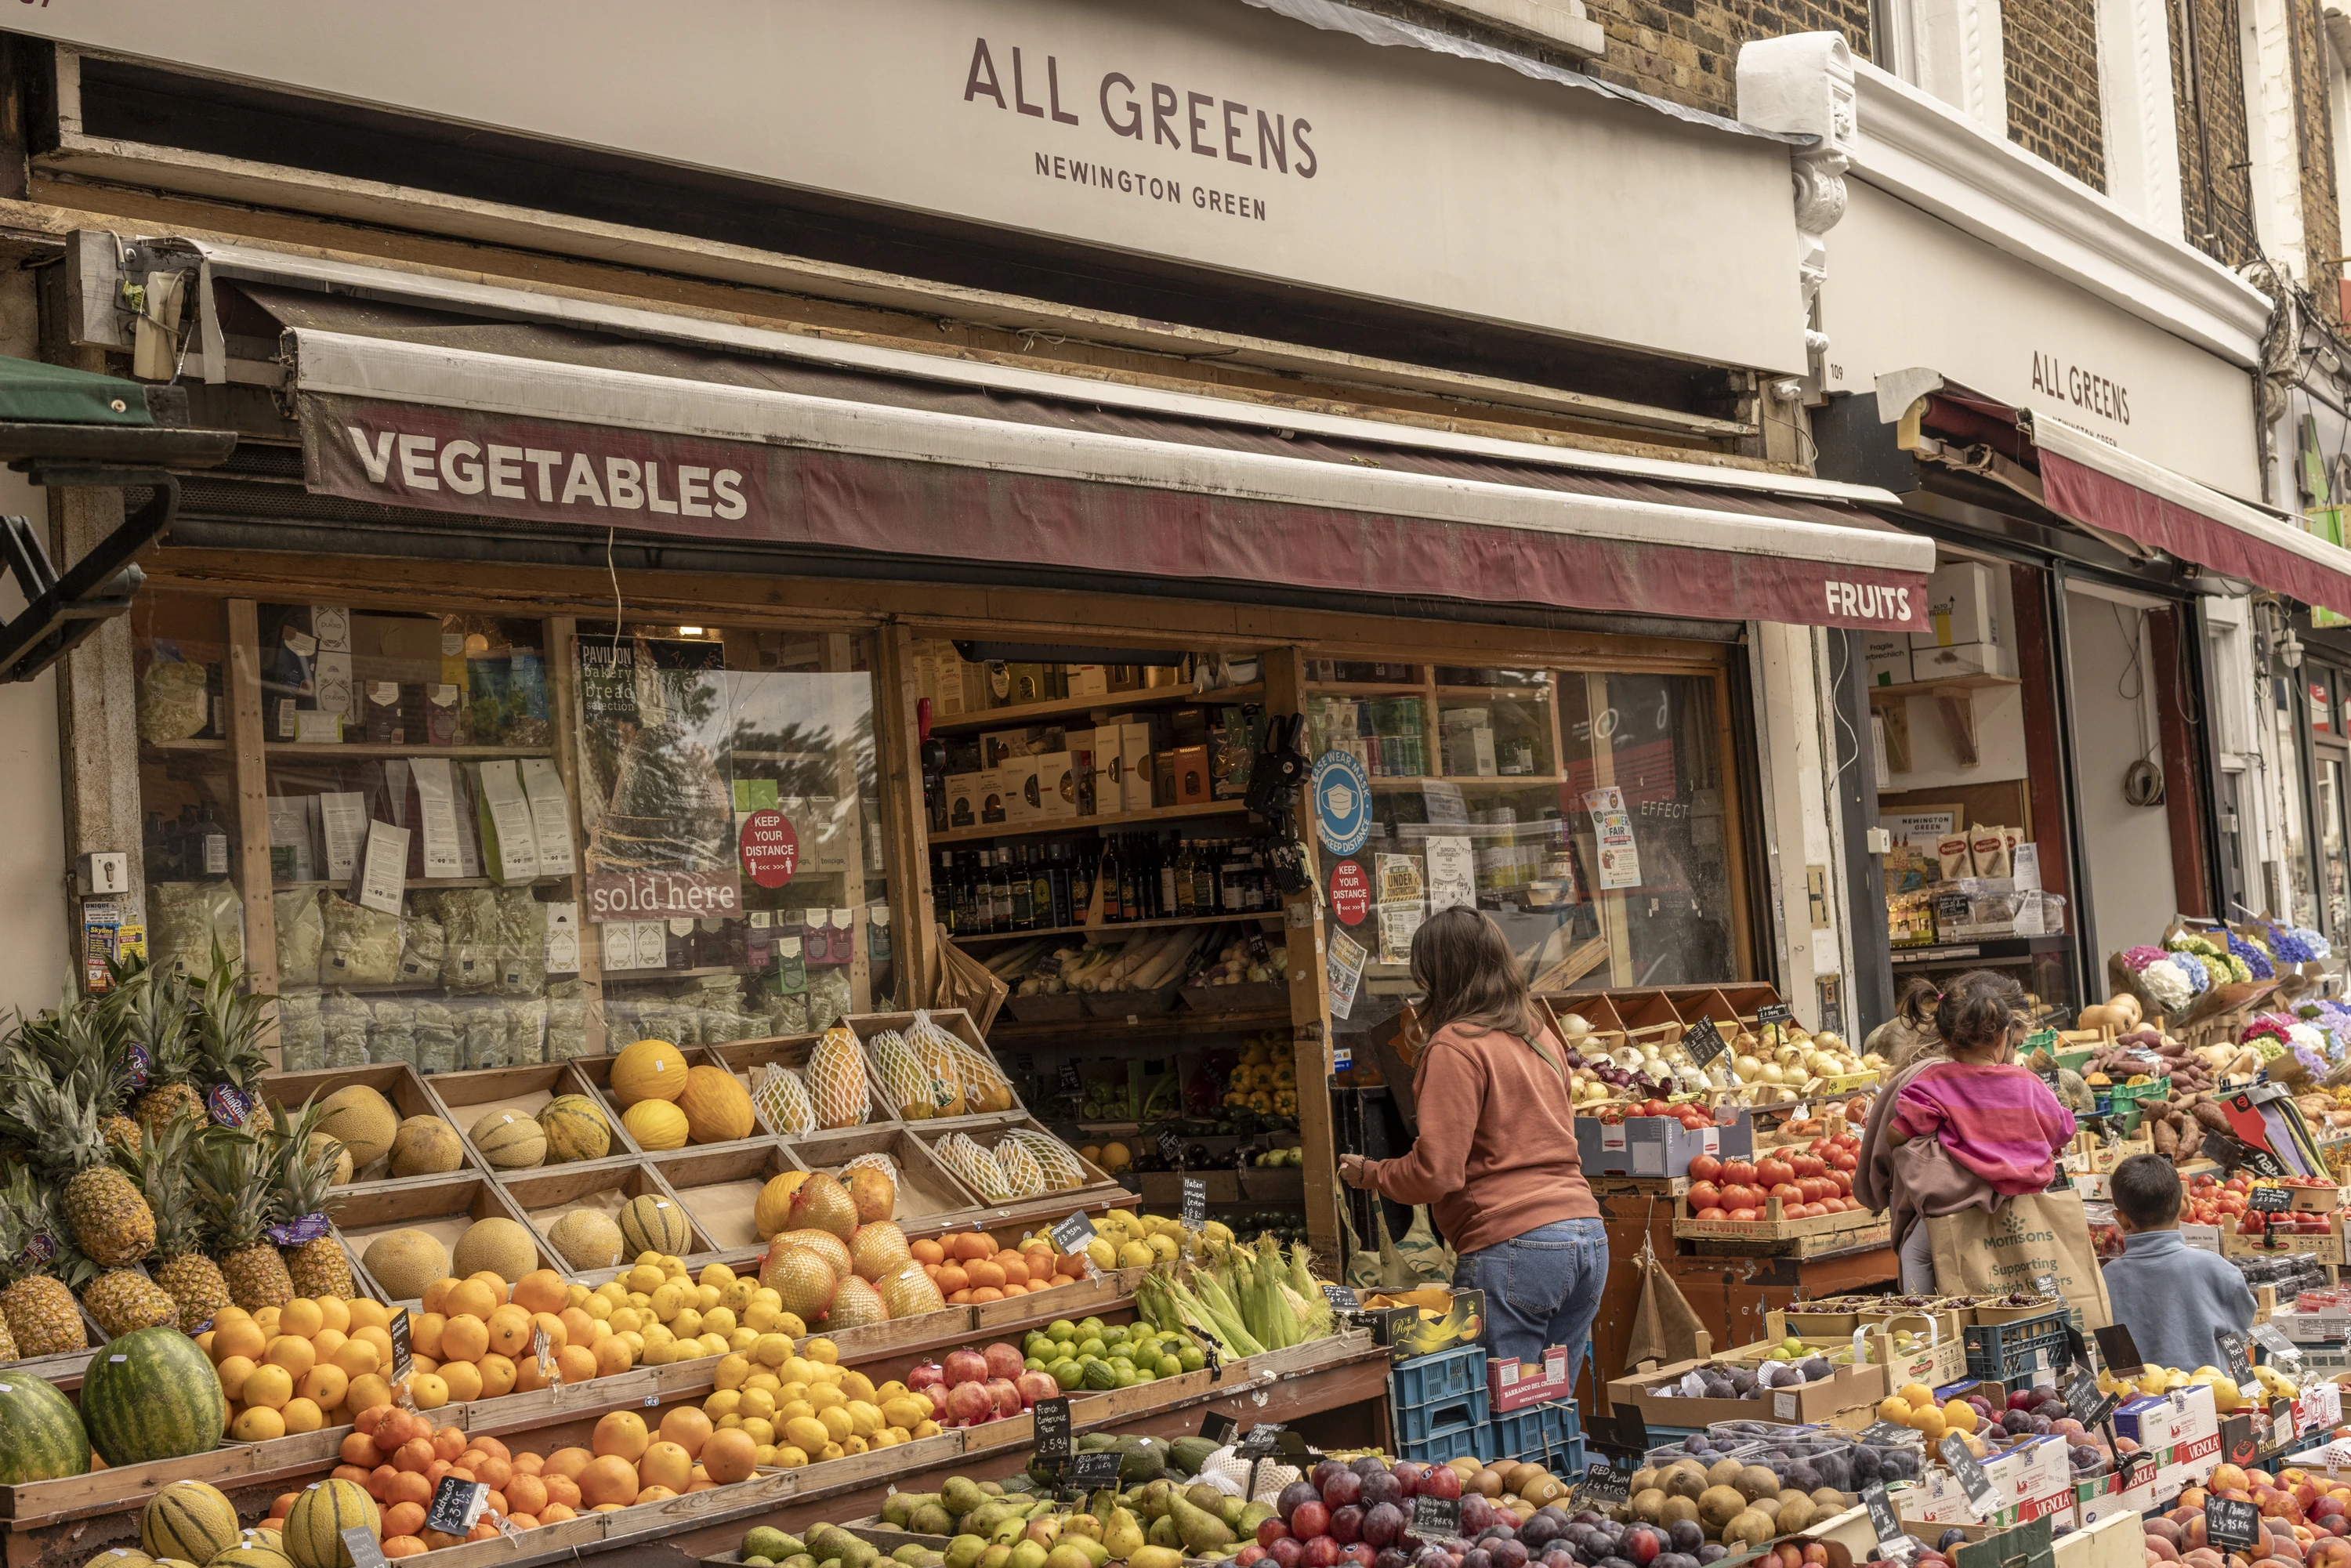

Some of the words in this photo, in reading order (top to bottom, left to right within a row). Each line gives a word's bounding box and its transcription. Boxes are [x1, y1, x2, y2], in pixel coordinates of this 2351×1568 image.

[964, 37, 1079, 126] ALL
[1099, 72, 1317, 179] GREENS
[1035, 152, 1181, 204] NEWINGTON
[1192, 186, 1266, 220] GREEN
[1831, 364, 1843, 380] 109
[2032, 350, 2065, 400] ALL
[2069, 365, 2130, 425] GREENS
[346, 426, 748, 520] VEGETABLES
[1825, 580, 1911, 621] FRUITS
[1870, 643, 1894, 651] Fragile
[585, 681, 633, 699] bread
[585, 701, 635, 712] selection
[1327, 751, 1351, 767] WEAR
[1351, 762, 1370, 798] MASK
[1641, 800, 1689, 820] EFFECT
[754, 816, 780, 827] KEEP
[1604, 816, 1629, 828] SUMMER
[755, 831, 783, 842] YOUR
[1324, 835, 1342, 852] KEEP
[1342, 817, 1370, 853] DISTANCE
[1609, 827, 1625, 836] FAIR
[745, 845, 795, 856] DISTANCE
[1940, 843, 1965, 853] Bonomi
[1975, 842, 1999, 851] Bonomi
[1339, 865, 1357, 875] KEEP
[1339, 877, 1359, 887] YOUR
[1388, 872, 1413, 888] UNDER
[594, 877, 659, 912] sold
[667, 877, 735, 910] here
[1333, 889, 1367, 900] DISTANCE
[1386, 885, 1417, 897] CONSTRUCTION
[90, 926, 114, 935] Skyline
[1184, 1179, 1203, 1189] Italian
[1983, 1230, 2054, 1250] Morrisons
[1992, 1258, 2058, 1277] Supporting
[1987, 1279, 2023, 1295] British
[1392, 1315, 1417, 1337] Royal
[2229, 1345, 2243, 1357] Peach
[1504, 1384, 1531, 1398] BARRANCO
[1531, 1382, 1541, 1390] DEL
[1037, 1404, 1058, 1415] French
[1041, 1425, 1056, 1434] Pear
[2189, 1437, 2219, 1459] VIGNOLA
[1077, 1455, 1090, 1464] RED
[1590, 1465, 1609, 1476] RED
[1609, 1472, 1630, 1483] PLUM
[1418, 1505, 1437, 1515] PLUM
[2035, 1492, 2070, 1517] VIGNOLA
